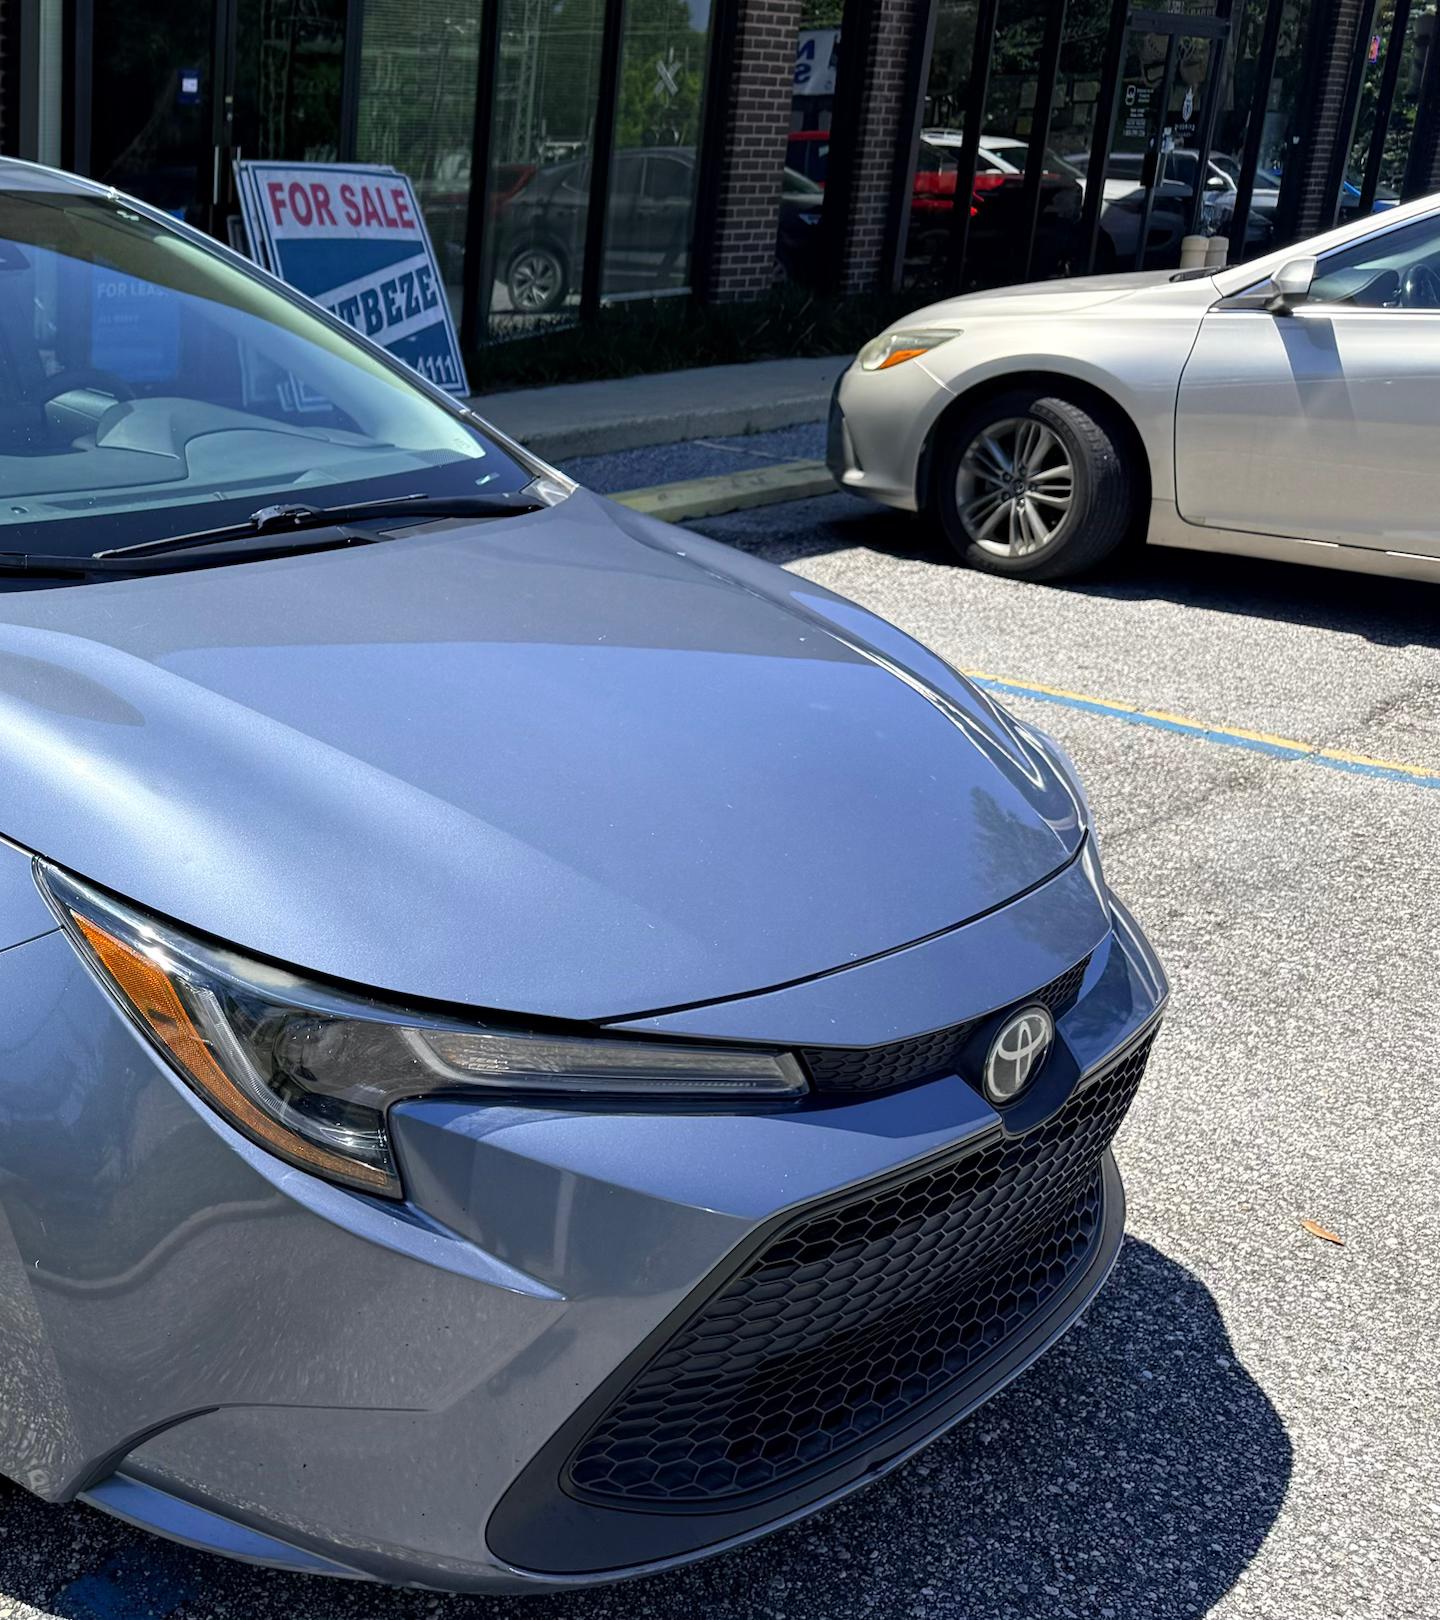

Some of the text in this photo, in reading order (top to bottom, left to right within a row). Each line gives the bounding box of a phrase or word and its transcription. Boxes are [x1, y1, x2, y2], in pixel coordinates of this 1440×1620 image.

[266, 182, 416, 229] FOR SALE
[97, 282, 127, 299] FOR
